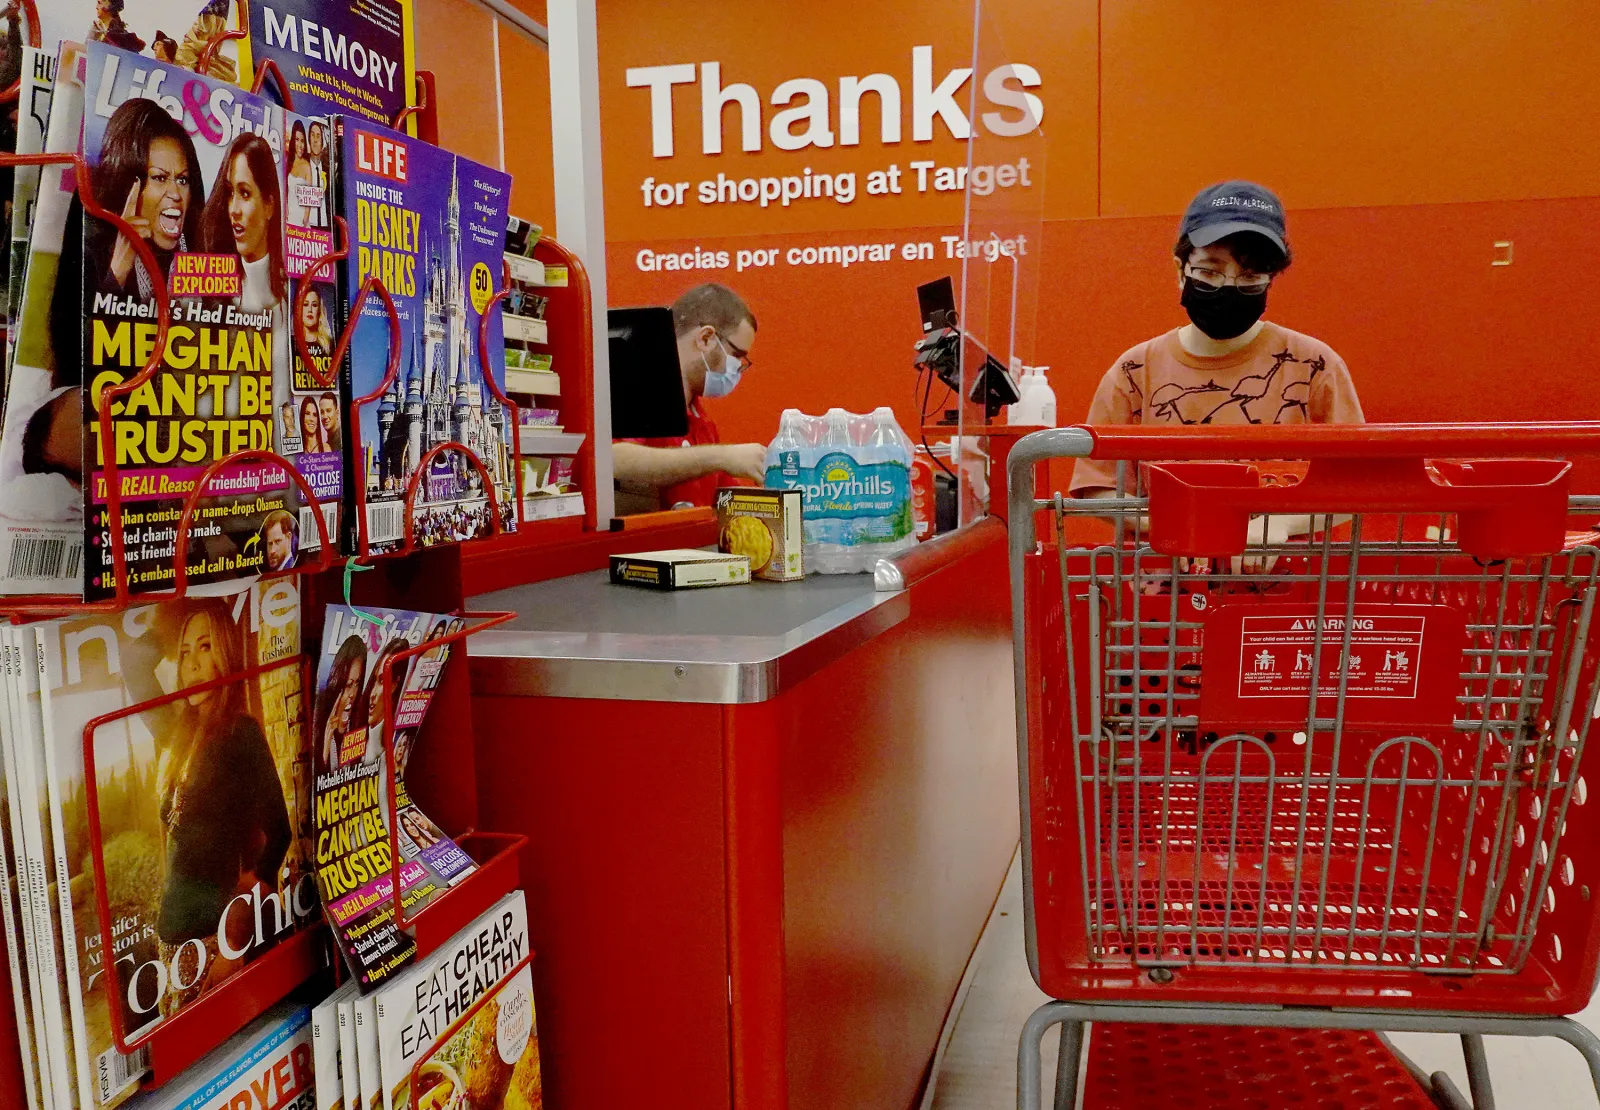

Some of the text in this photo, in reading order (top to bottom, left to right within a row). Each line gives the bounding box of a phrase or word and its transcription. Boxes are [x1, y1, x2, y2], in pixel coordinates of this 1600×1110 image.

[263, 6, 398, 92] MEMORY
[297, 65, 384, 109] What It Is, How It Works,
[626, 45, 1044, 158] Thanks
[290, 81, 390, 125] and Ways You Can Improve It
[357, 134, 406, 180] LIFE
[356, 180, 403, 206] INSIDE THE
[642, 157, 1032, 208] for shopping at Target
[1211, 196, 1274, 213] FEELIN ALRIGHT
[356, 198, 421, 254] DISNEY
[287, 236, 328, 259] WEDDING
[636, 233, 1028, 272] Gracias por comprar en Target
[177, 255, 236, 275] NEW FEUD
[287, 256, 295, 273] IN
[358, 246, 416, 298] PARKS
[173, 277, 239, 295] EXPLODES!
[475, 268, 488, 292] 50
[187, 302, 273, 331] Had Enough!
[92, 320, 272, 372] MEGHAN
[91, 370, 272, 416] CAN'T BE
[91, 418, 274, 465] TRUSTED!
[786, 453, 793, 463] 6
[121, 467, 286, 497] REAL Reaso Ended
[317, 470, 340, 486] CLOSE
[202, 497, 284, 518] name-drops Obamas
[853, 502, 874, 511] SPRING
[875, 501, 893, 510] WATER
[142, 526, 178, 543] charity
[194, 521, 221, 538] make
[207, 550, 265, 572] call to Barack
[262, 645, 293, 663] Fashion
[269, 635, 286, 648] The
[343, 733, 355, 749] NEW
[317, 756, 380, 792] Michelle's Had Enough!
[316, 775, 379, 829] MEGHAN
[317, 807, 387, 865] CAN'T BE
[430, 847, 464, 871] TOO CLOSE
[333, 908, 347, 922] The
[342, 899, 364, 919] REAL
[359, 892, 381, 908] Reason
[402, 864, 425, 883] Ended
[217, 867, 317, 961] Chic
[346, 924, 369, 941] Meghan
[411, 883, 436, 899] Obamas
[143, 923, 155, 939] is
[354, 934, 375, 954] Started
[360, 947, 382, 967] famous
[367, 961, 391, 983] Harry's
[401, 1005, 441, 1060] EAT
[444, 931, 524, 1026] HEALTHY
[416, 961, 450, 1015] EAT
[193, 1095, 206, 1108] ALL
[205, 1086, 216, 1096] OF
[216, 1077, 229, 1089] THE
[253, 1044, 271, 1060] NONE
[270, 1036, 279, 1046] OF
[278, 1028, 290, 1040] THE
